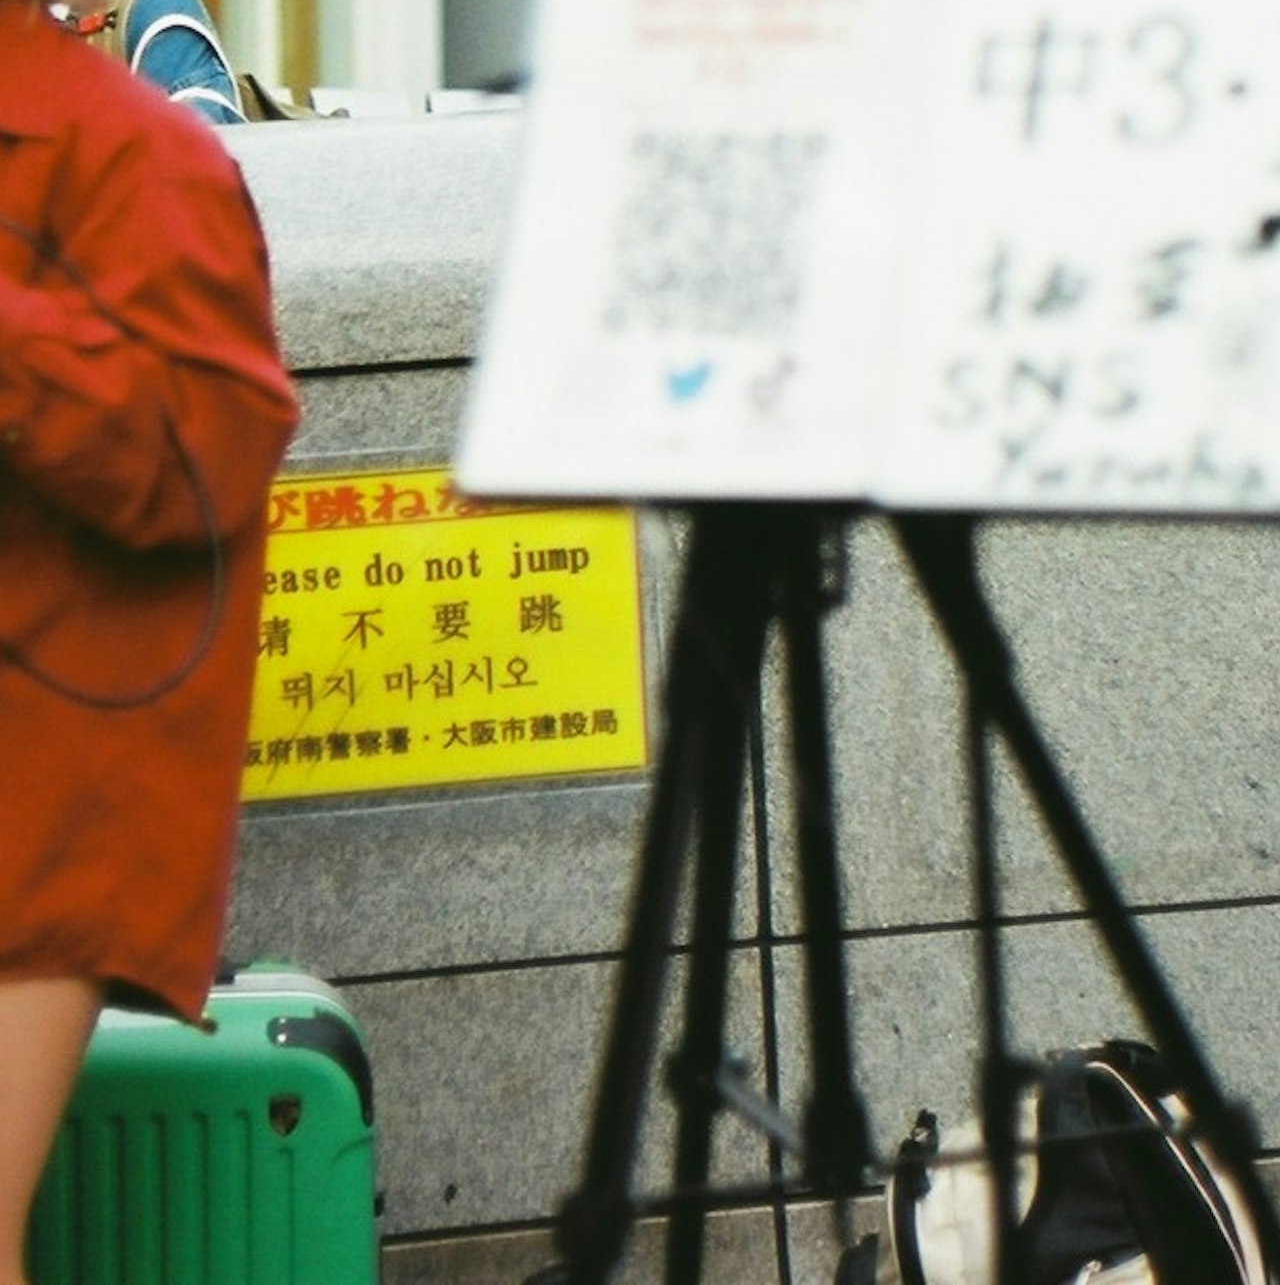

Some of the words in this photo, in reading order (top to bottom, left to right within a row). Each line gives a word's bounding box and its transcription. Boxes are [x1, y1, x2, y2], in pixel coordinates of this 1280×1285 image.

[931, 350, 1144, 424] SNS
[364, 552, 404, 587] do
[424, 547, 482, 582] not
[509, 541, 591, 580] jump
[281, 668, 356, 712] 뛰지
[382, 655, 539, 702] 마십시오
